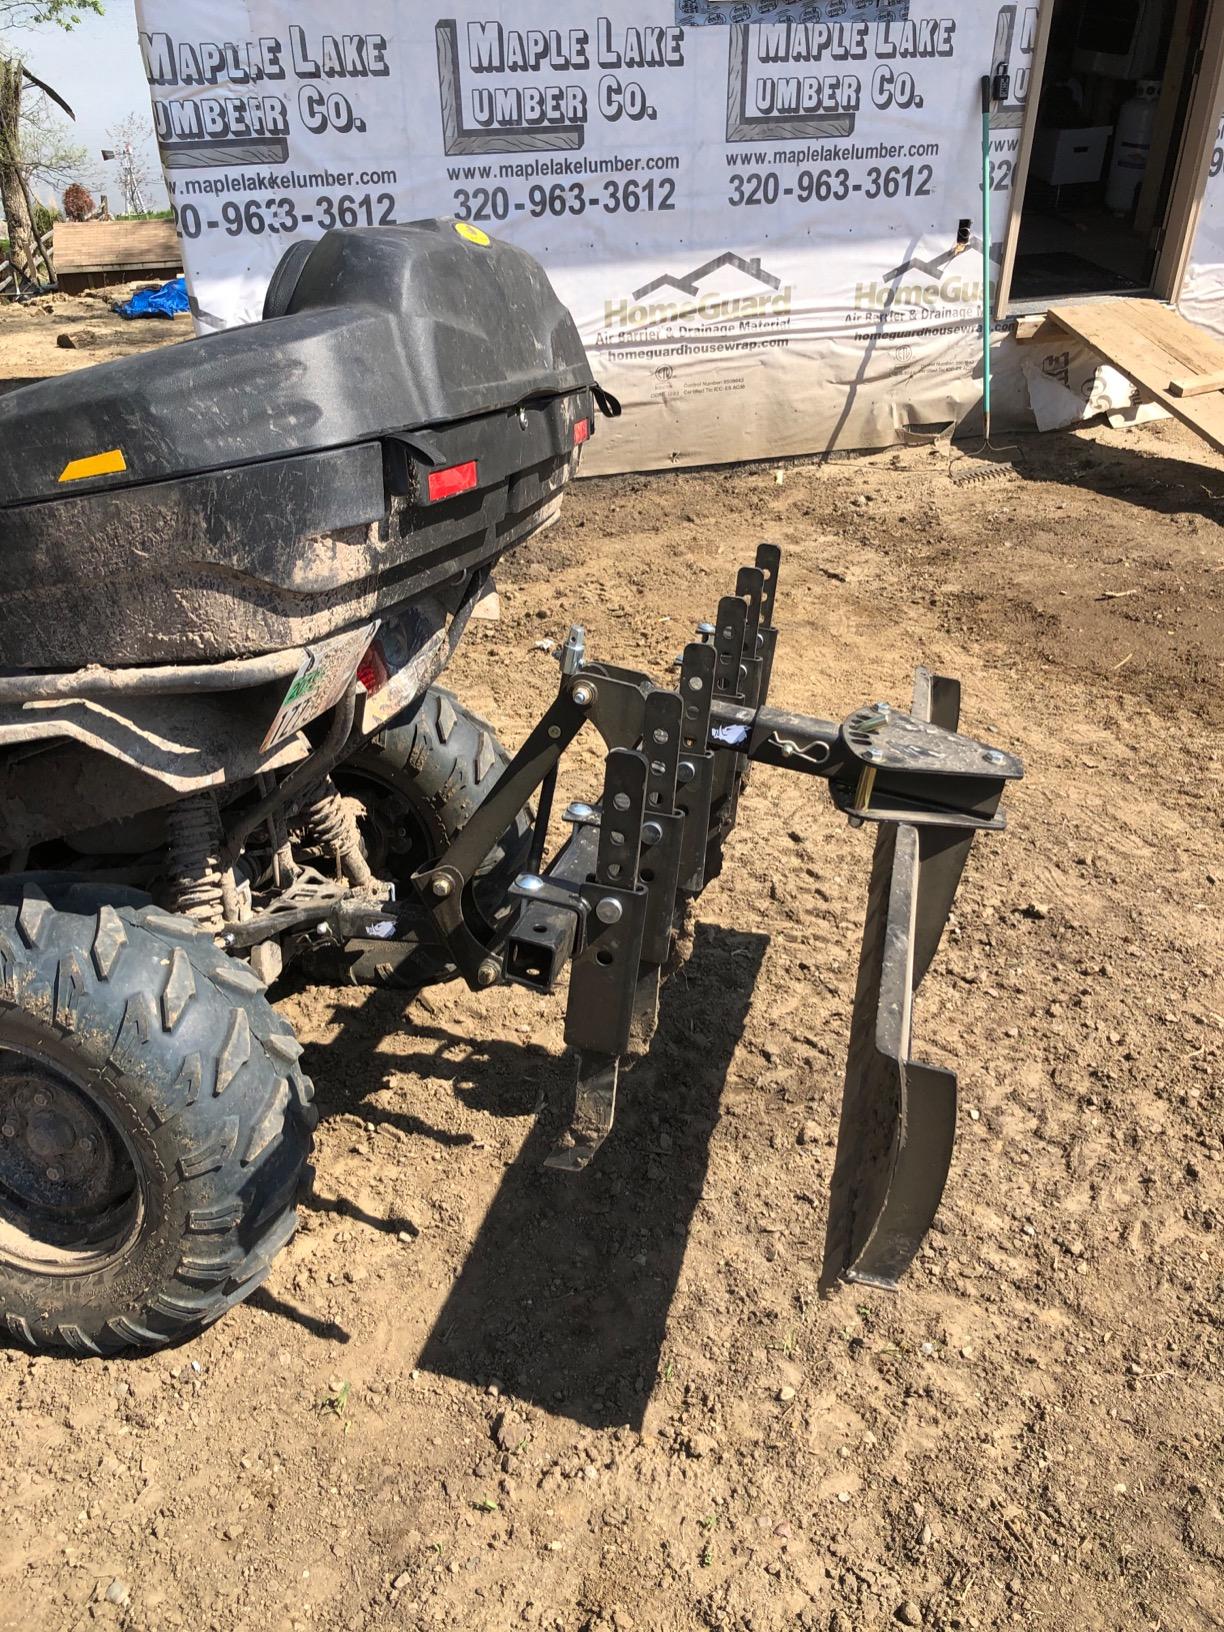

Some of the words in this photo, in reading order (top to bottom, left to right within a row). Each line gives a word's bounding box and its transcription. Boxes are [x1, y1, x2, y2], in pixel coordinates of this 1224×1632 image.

[289, 25, 390, 79] LAKE
[467, 21, 590, 73] MAPLE
[597, 17, 685, 69] LAKE
[758, 20, 869, 63] MAPLE
[875, 18, 956, 60] LAKE
[598, 74, 658, 122] CO.
[871, 64, 924, 110] CO.
[298, 84, 367, 135] CO.
[447, 155, 680, 181] www.maplelakelumber.com
[726, 142, 939, 167] www.maplelakelumber.com
[453, 178, 676, 222] 320-963-3612
[728, 164, 934, 207] 320-963-3612
[604, 286, 792, 328] HomeGuard
[608, 338, 789, 361] homeguardhousewrap.com
